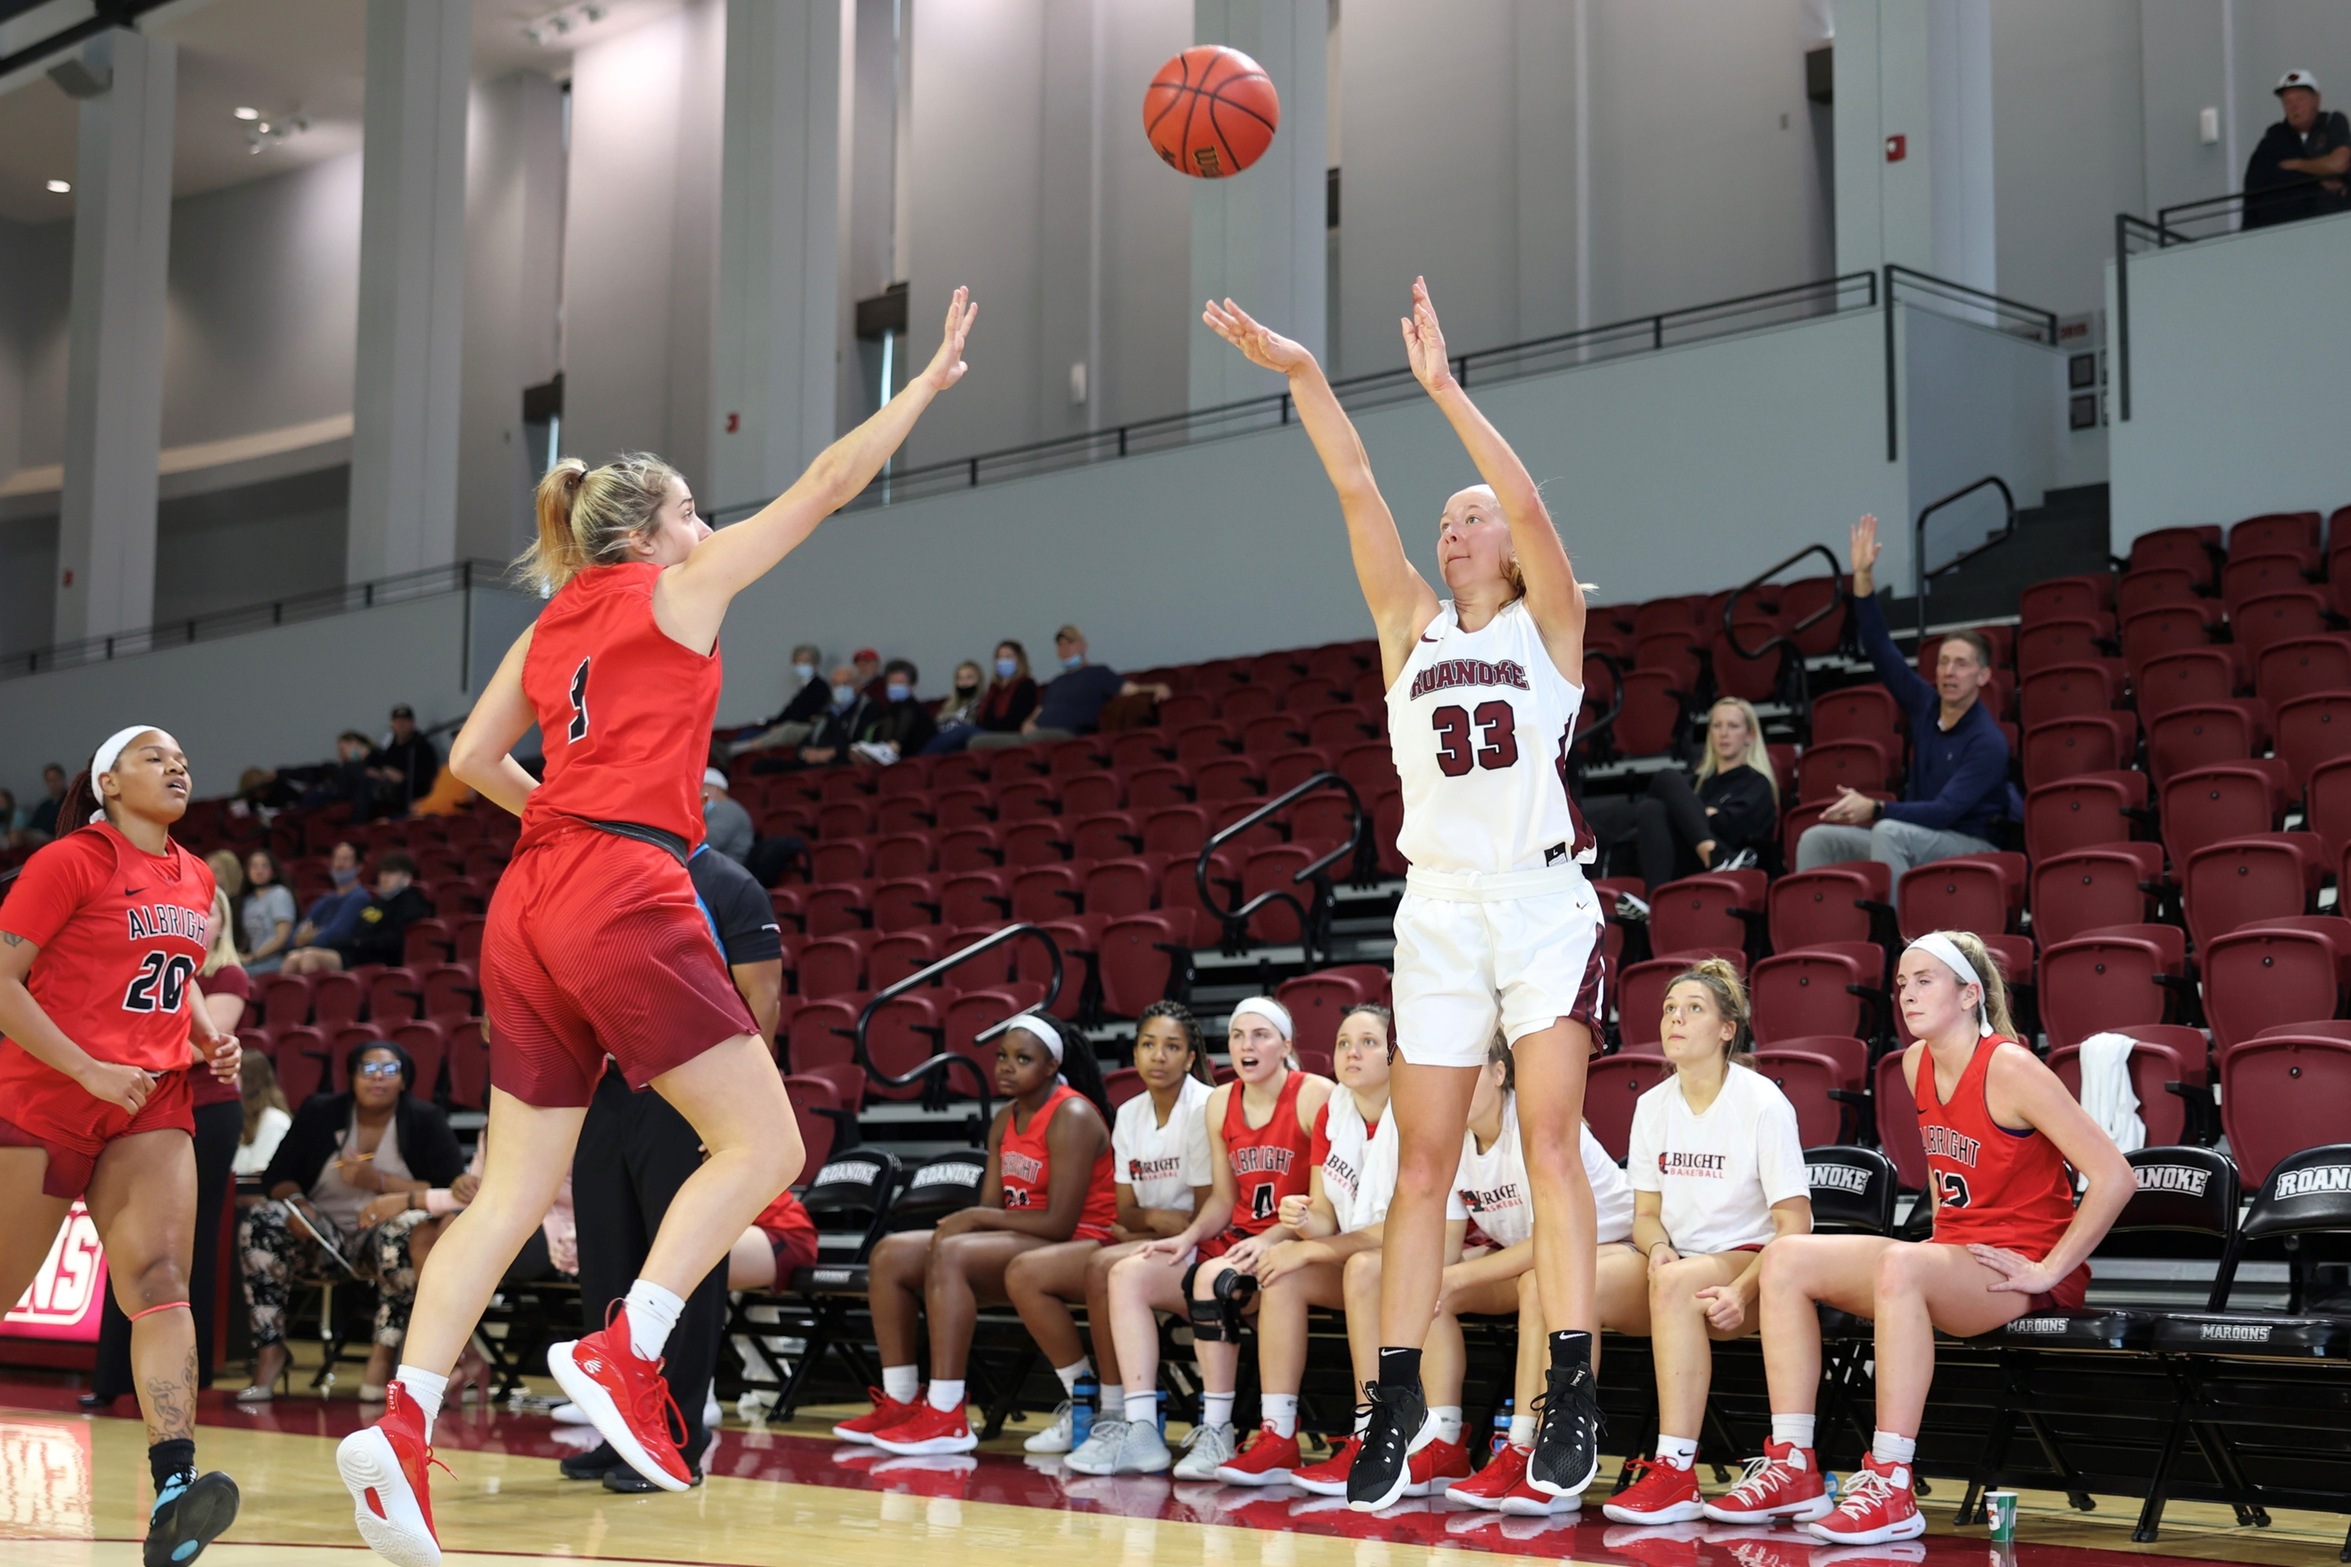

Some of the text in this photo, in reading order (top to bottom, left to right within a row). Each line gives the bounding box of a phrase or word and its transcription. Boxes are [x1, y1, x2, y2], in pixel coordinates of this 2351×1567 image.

[1409, 658, 1531, 702] ROANOKE
[1431, 699, 1519, 778] 33
[126, 903, 208, 951] ALBRIGH
[121, 950, 197, 1015] 20
[1228, 1144, 1296, 1177] LBRIGHT
[1919, 1125, 1981, 1169] LBRIGHT
[2274, 1165, 2351, 1201] ROAN
[2005, 1317, 2071, 1335] MAROONS
[2201, 1323, 2272, 1342] MAROONS
